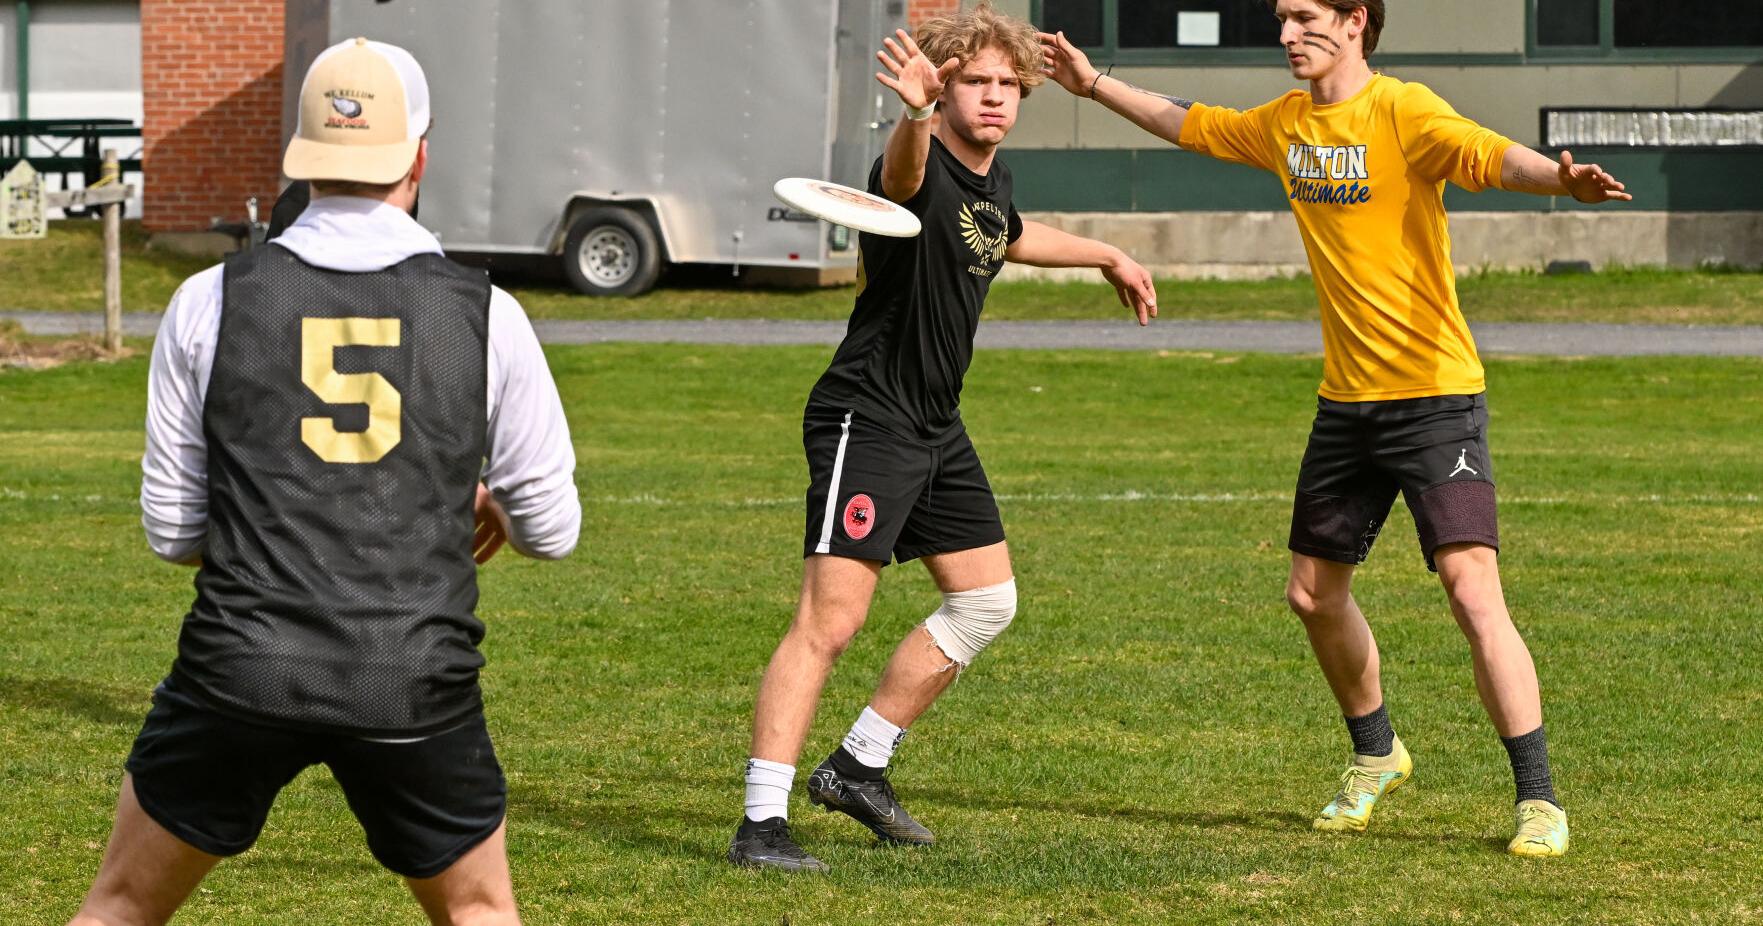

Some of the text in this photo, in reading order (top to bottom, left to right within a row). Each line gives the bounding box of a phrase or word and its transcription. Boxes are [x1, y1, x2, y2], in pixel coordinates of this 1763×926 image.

[340, 89, 375, 100] KELLUM
[1287, 144, 1368, 180] MILTON
[1290, 178, 1371, 205] Ultimate
[301, 317, 402, 463] 5
